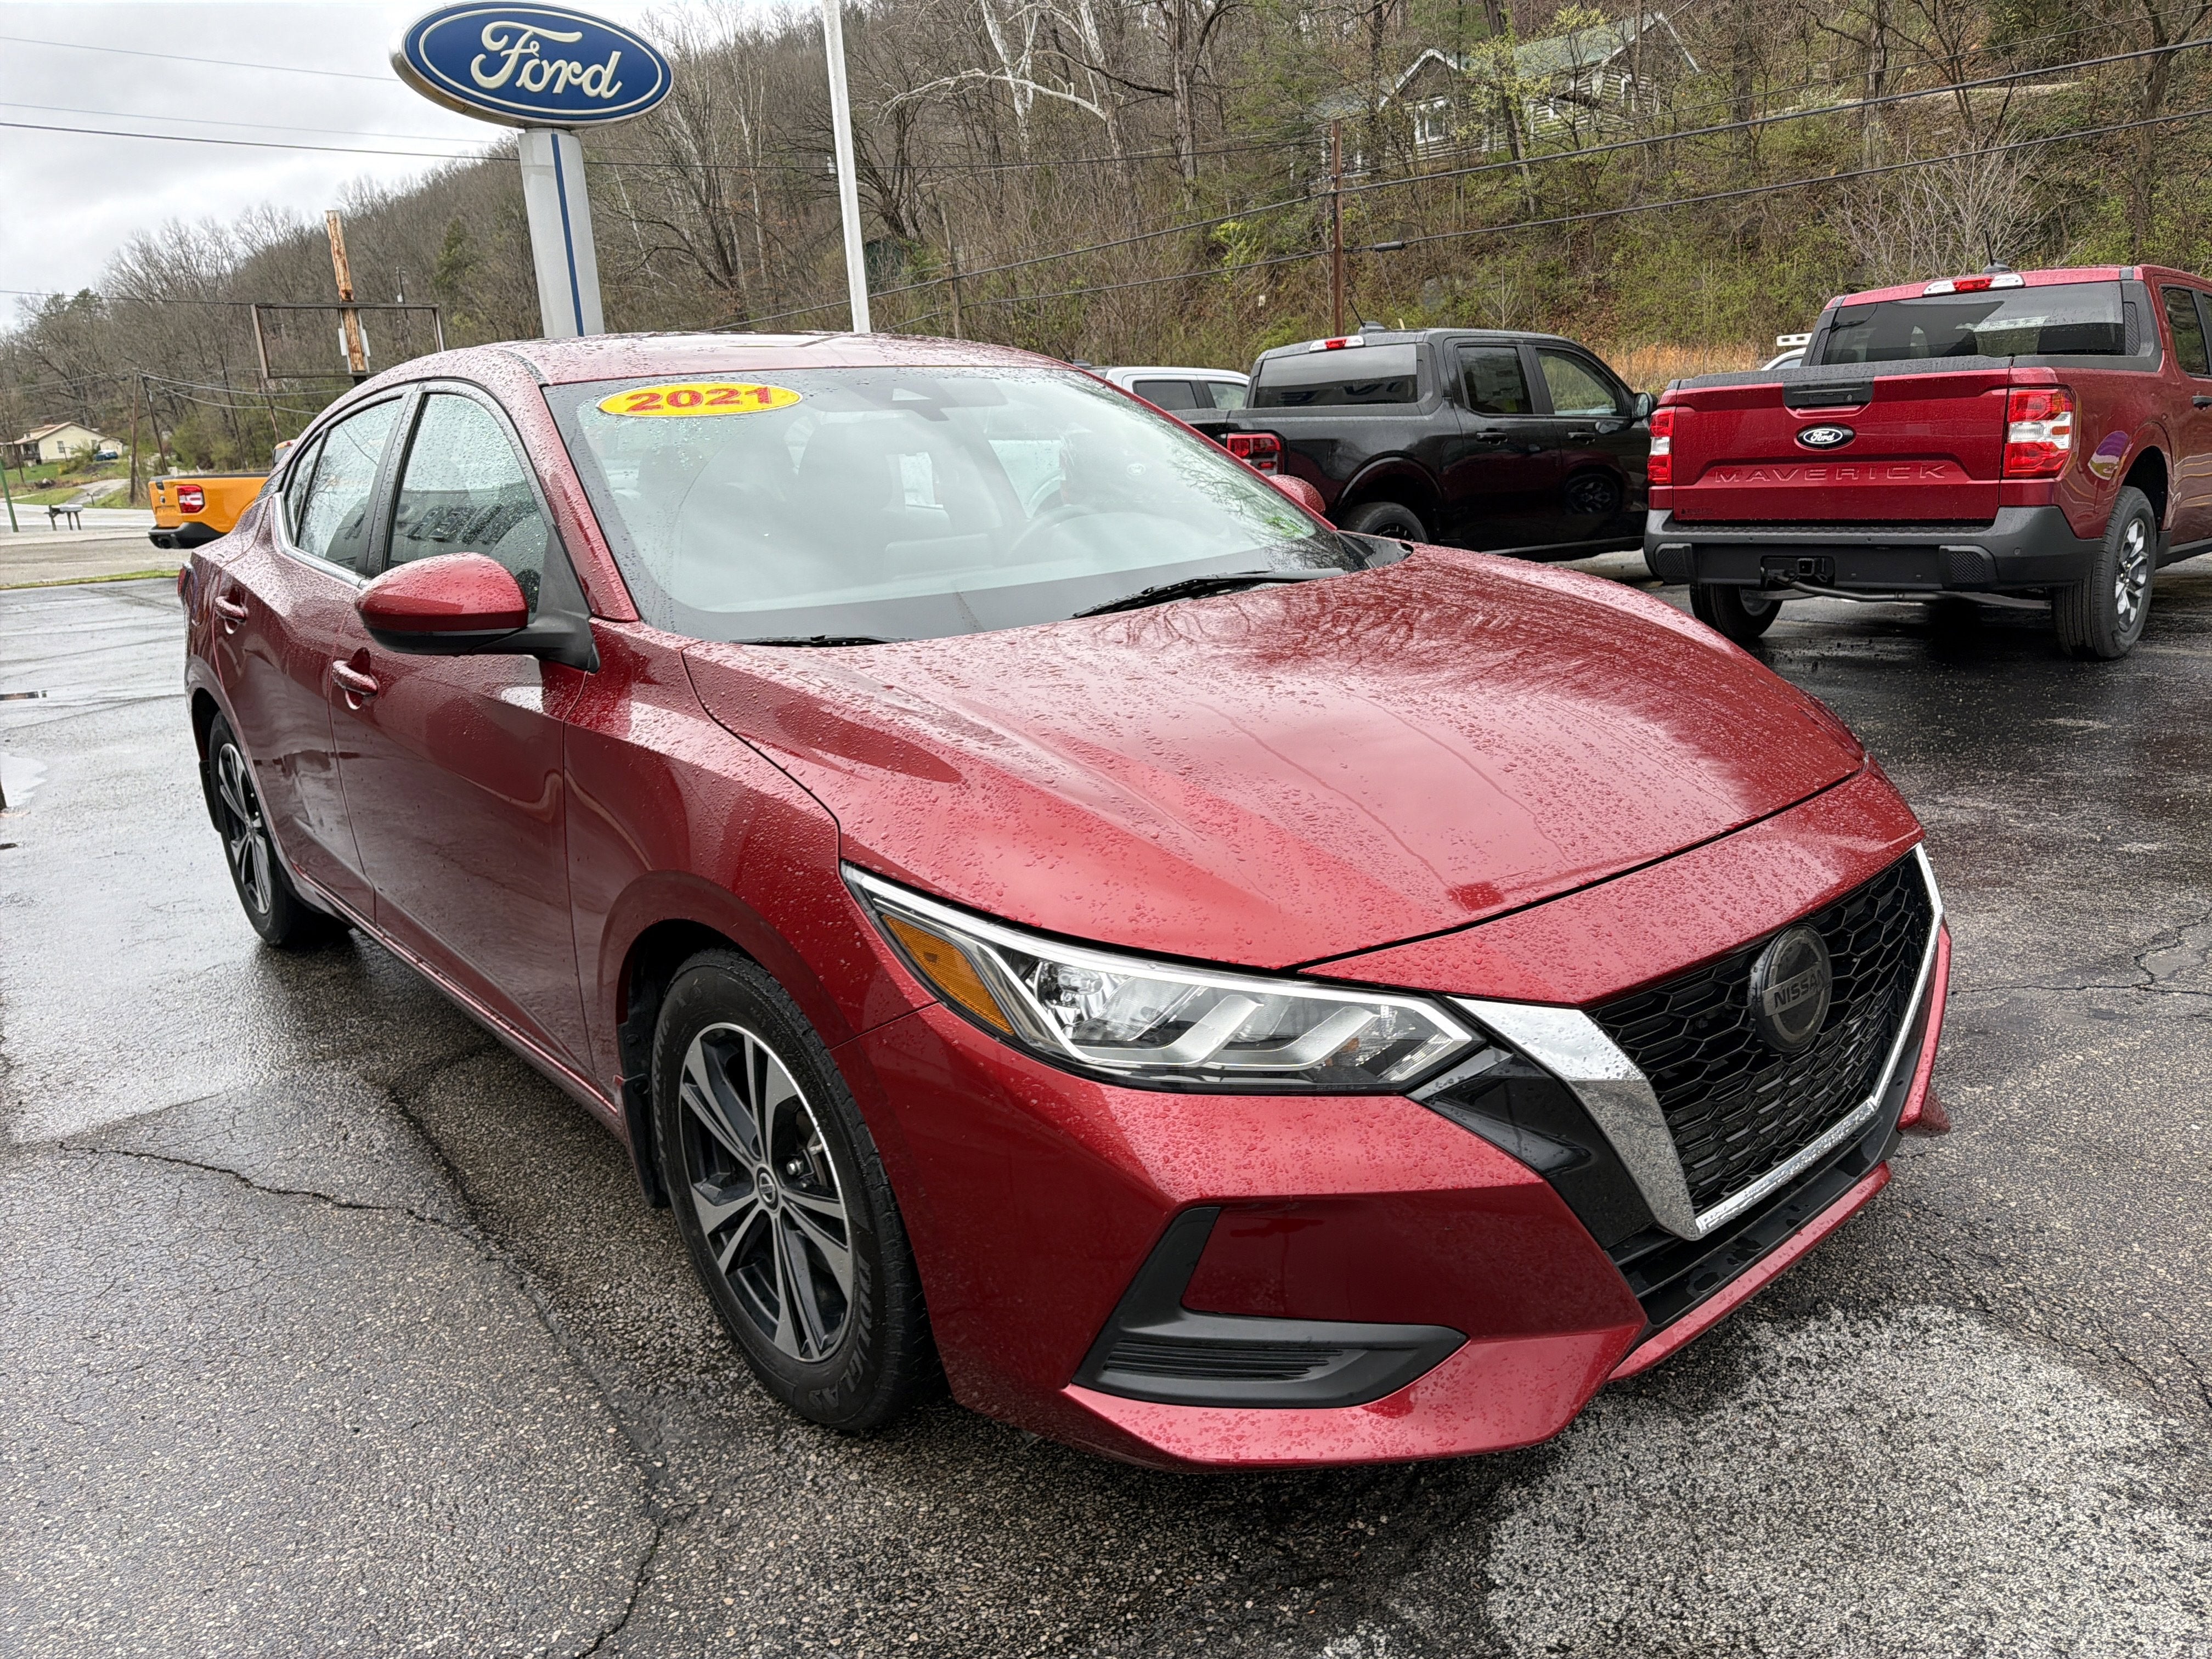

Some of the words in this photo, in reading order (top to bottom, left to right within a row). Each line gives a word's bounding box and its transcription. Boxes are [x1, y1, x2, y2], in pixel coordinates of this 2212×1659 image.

[471, 21, 623, 99] Ford
[625, 386, 773, 412] 2021
[1810, 431, 1836, 441] Ford
[1715, 465, 1946, 483] MAVERICK
[1773, 969, 1825, 1009] NISSAN
[809, 1251, 872, 1409] DOUGLAS
